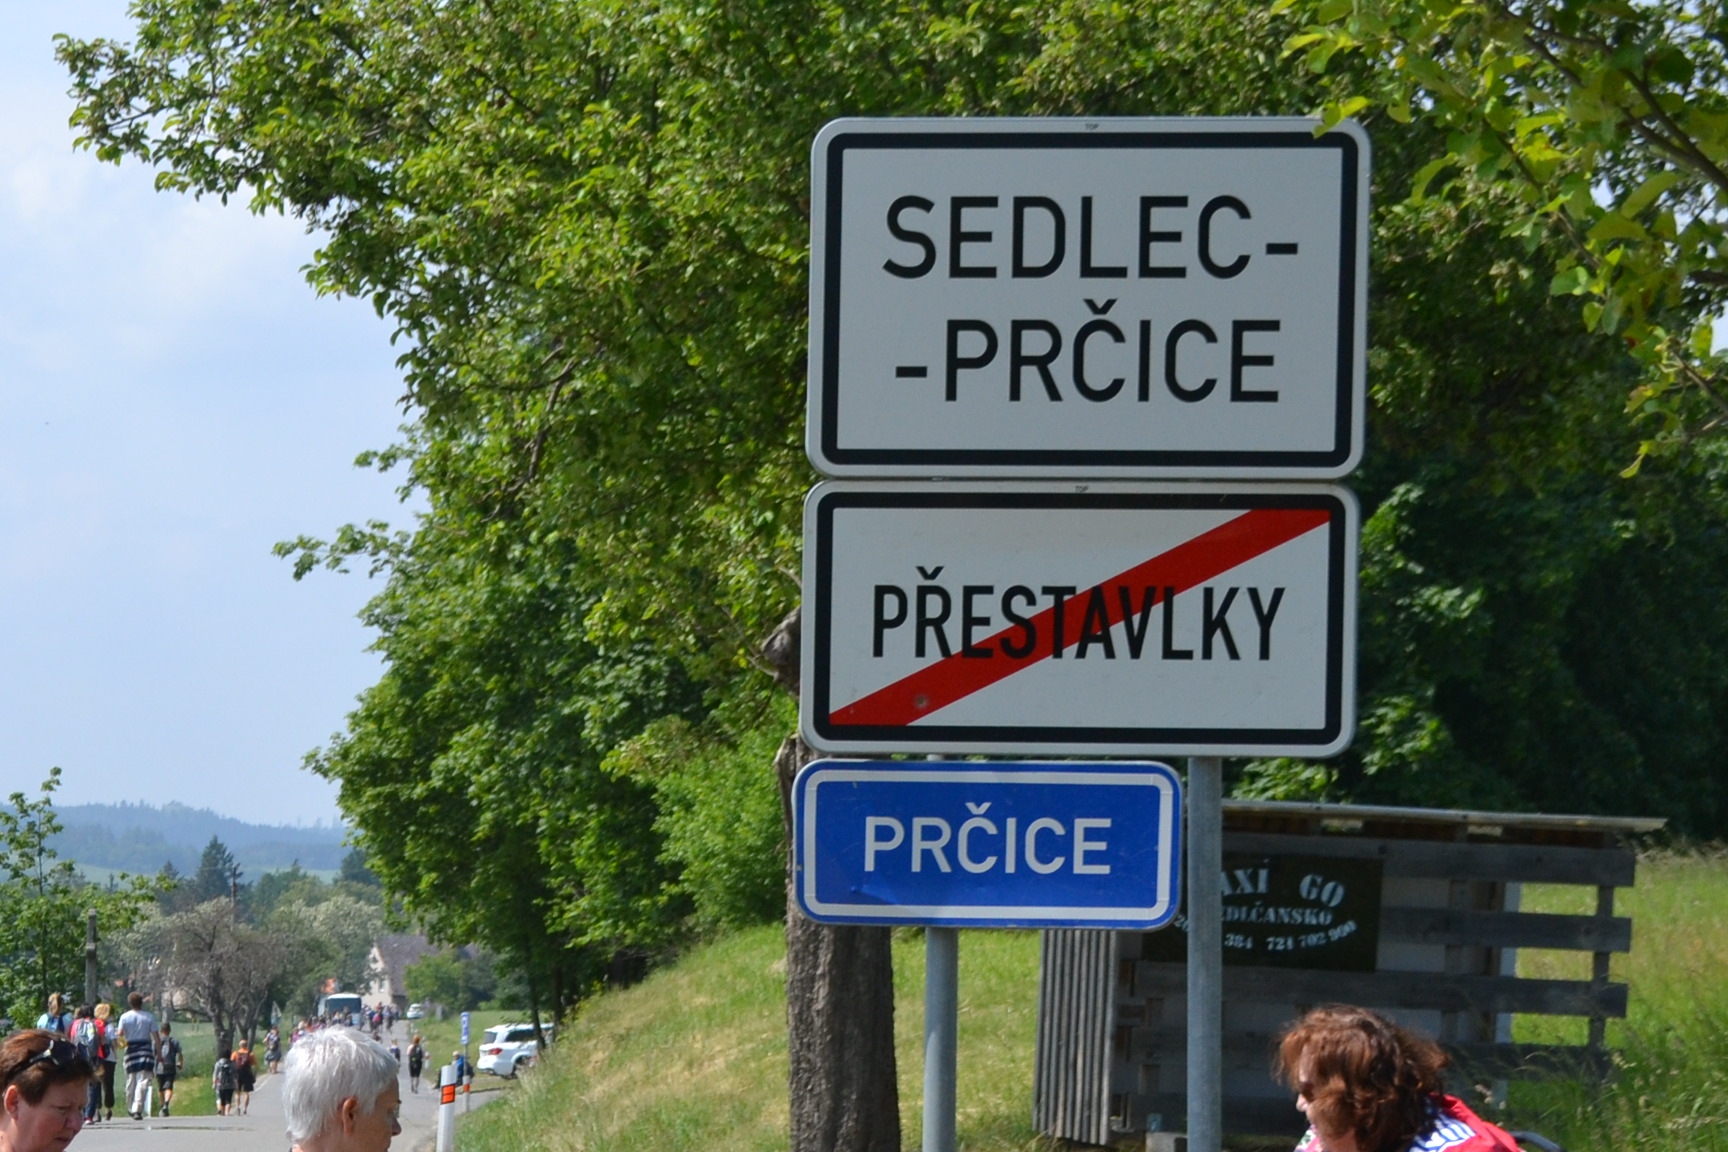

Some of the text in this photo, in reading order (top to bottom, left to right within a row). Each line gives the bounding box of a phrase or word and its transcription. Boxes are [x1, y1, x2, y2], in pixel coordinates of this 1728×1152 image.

[882, 195, 1299, 279] SEDLEC-
[894, 298, 1282, 403] -PRČICE
[871, 565, 1286, 662] PŘESTAVLKY
[863, 801, 1113, 876] PRČICE
[1298, 873, 1346, 908] GO
